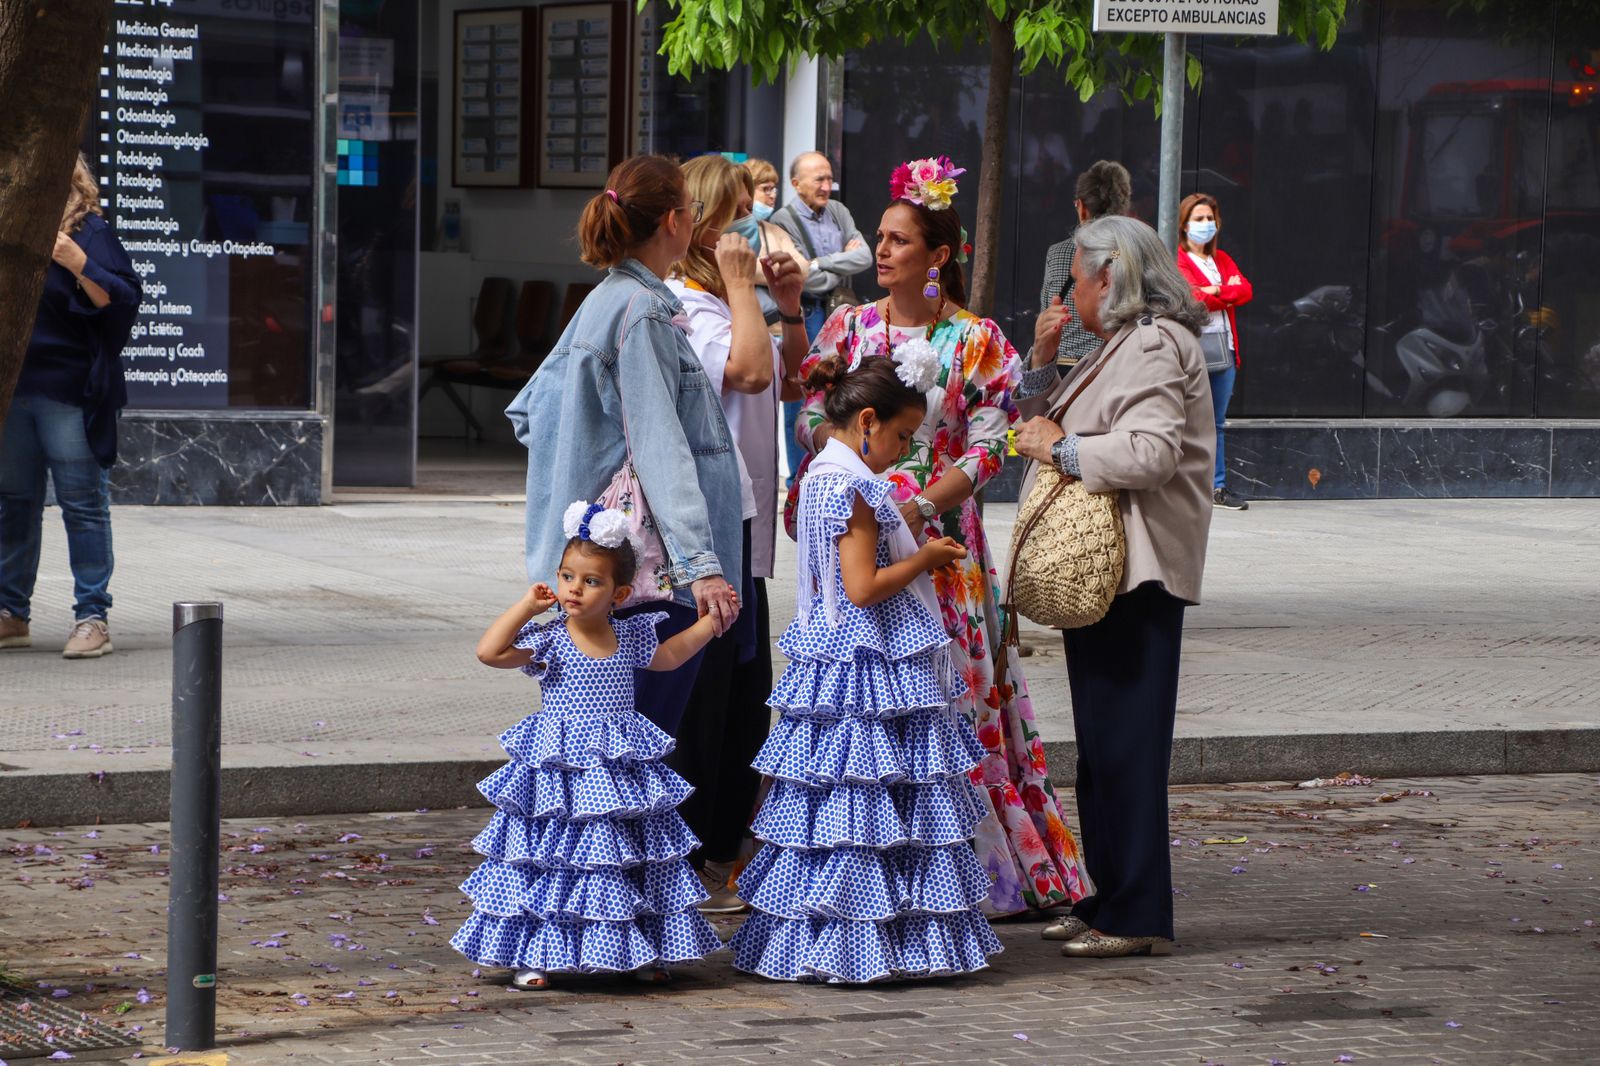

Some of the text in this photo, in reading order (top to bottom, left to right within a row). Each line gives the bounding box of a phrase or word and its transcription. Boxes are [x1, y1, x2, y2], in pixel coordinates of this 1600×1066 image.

[1107, 8, 1266, 25] EXCEPTO AMBULANCIAS
[117, 20, 198, 38] Medicina General
[117, 42, 192, 60] Medicina Infantil
[182, 243, 189, 257] y
[159, 300, 192, 315] Interna
[120, 343, 204, 361] cupuntura y Coach
[124, 368, 169, 386] sioterapia
